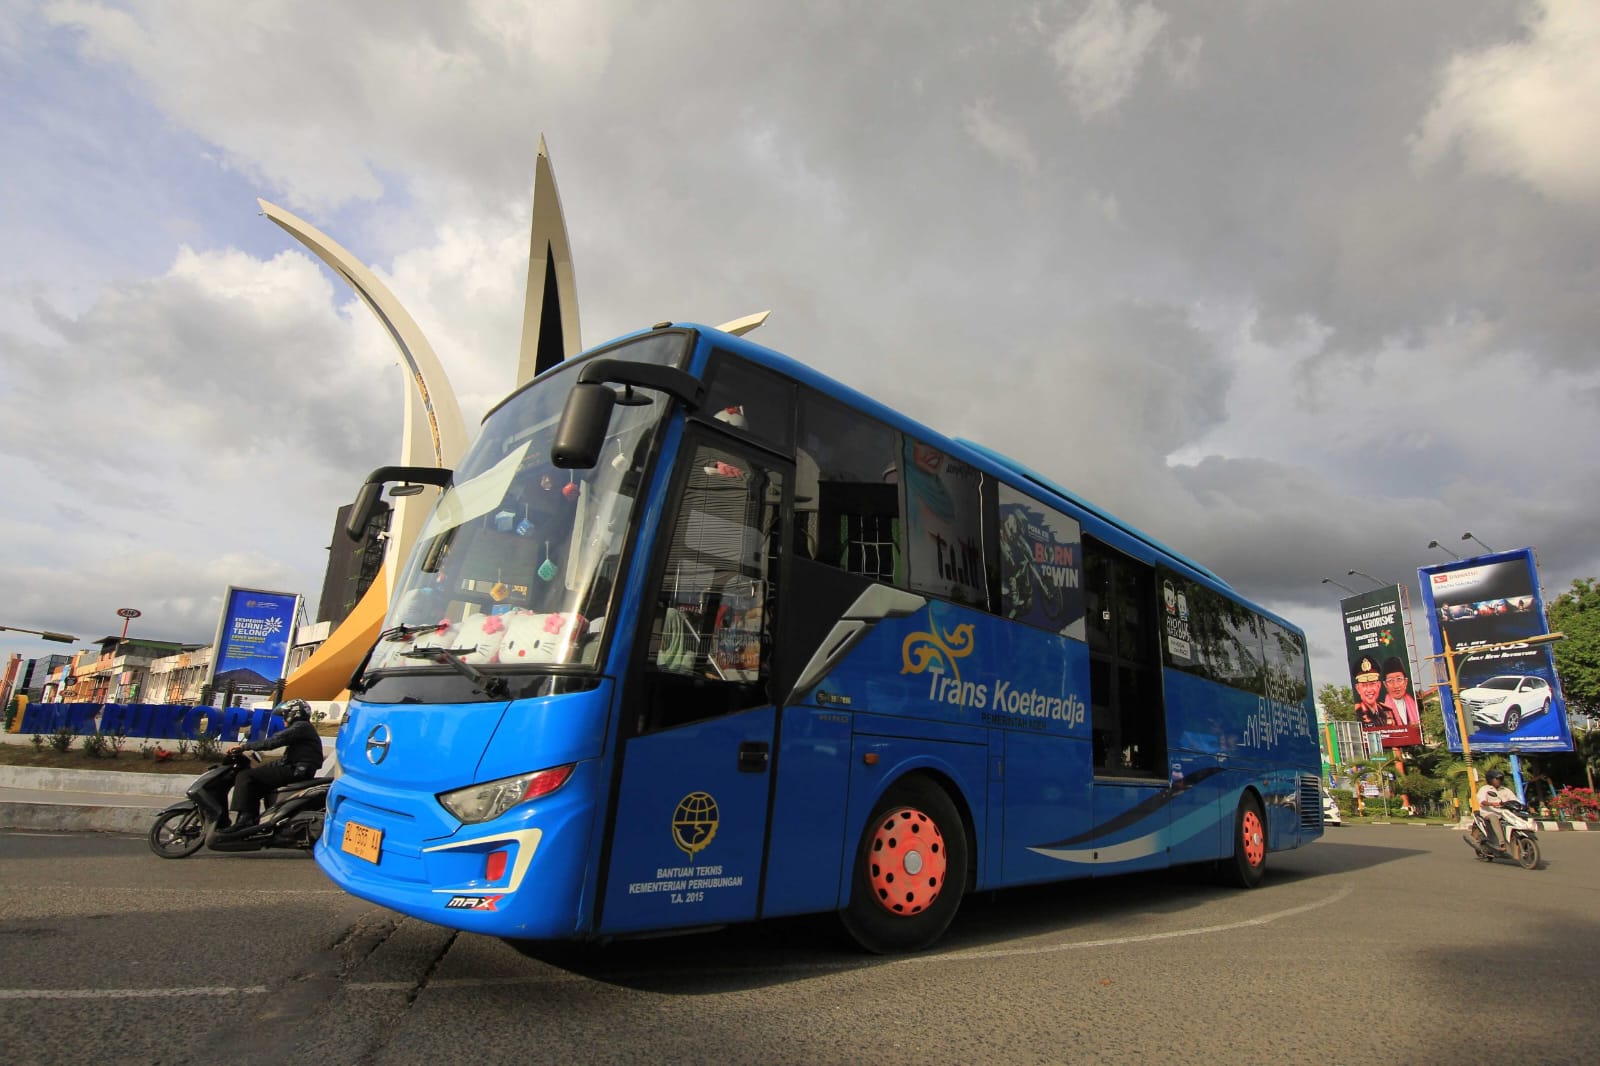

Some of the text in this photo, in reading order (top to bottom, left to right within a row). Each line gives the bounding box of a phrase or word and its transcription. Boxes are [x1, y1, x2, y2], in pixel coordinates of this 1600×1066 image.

[1053, 567, 1079, 588] WIN
[1380, 604, 1396, 615] TIDAK
[235, 621, 263, 630] BURNI
[1362, 614, 1395, 630] TERORISME
[233, 628, 267, 636] TELONG
[928, 665, 1085, 729] Trans Koetaradja
[656, 865, 723, 879] BANTUAN TEKNIS
[628, 876, 743, 894] KEMENTERIAN PERHUBUNGAN
[447, 897, 494, 908] MAX
[670, 892, 705, 904] T.A. 2015
